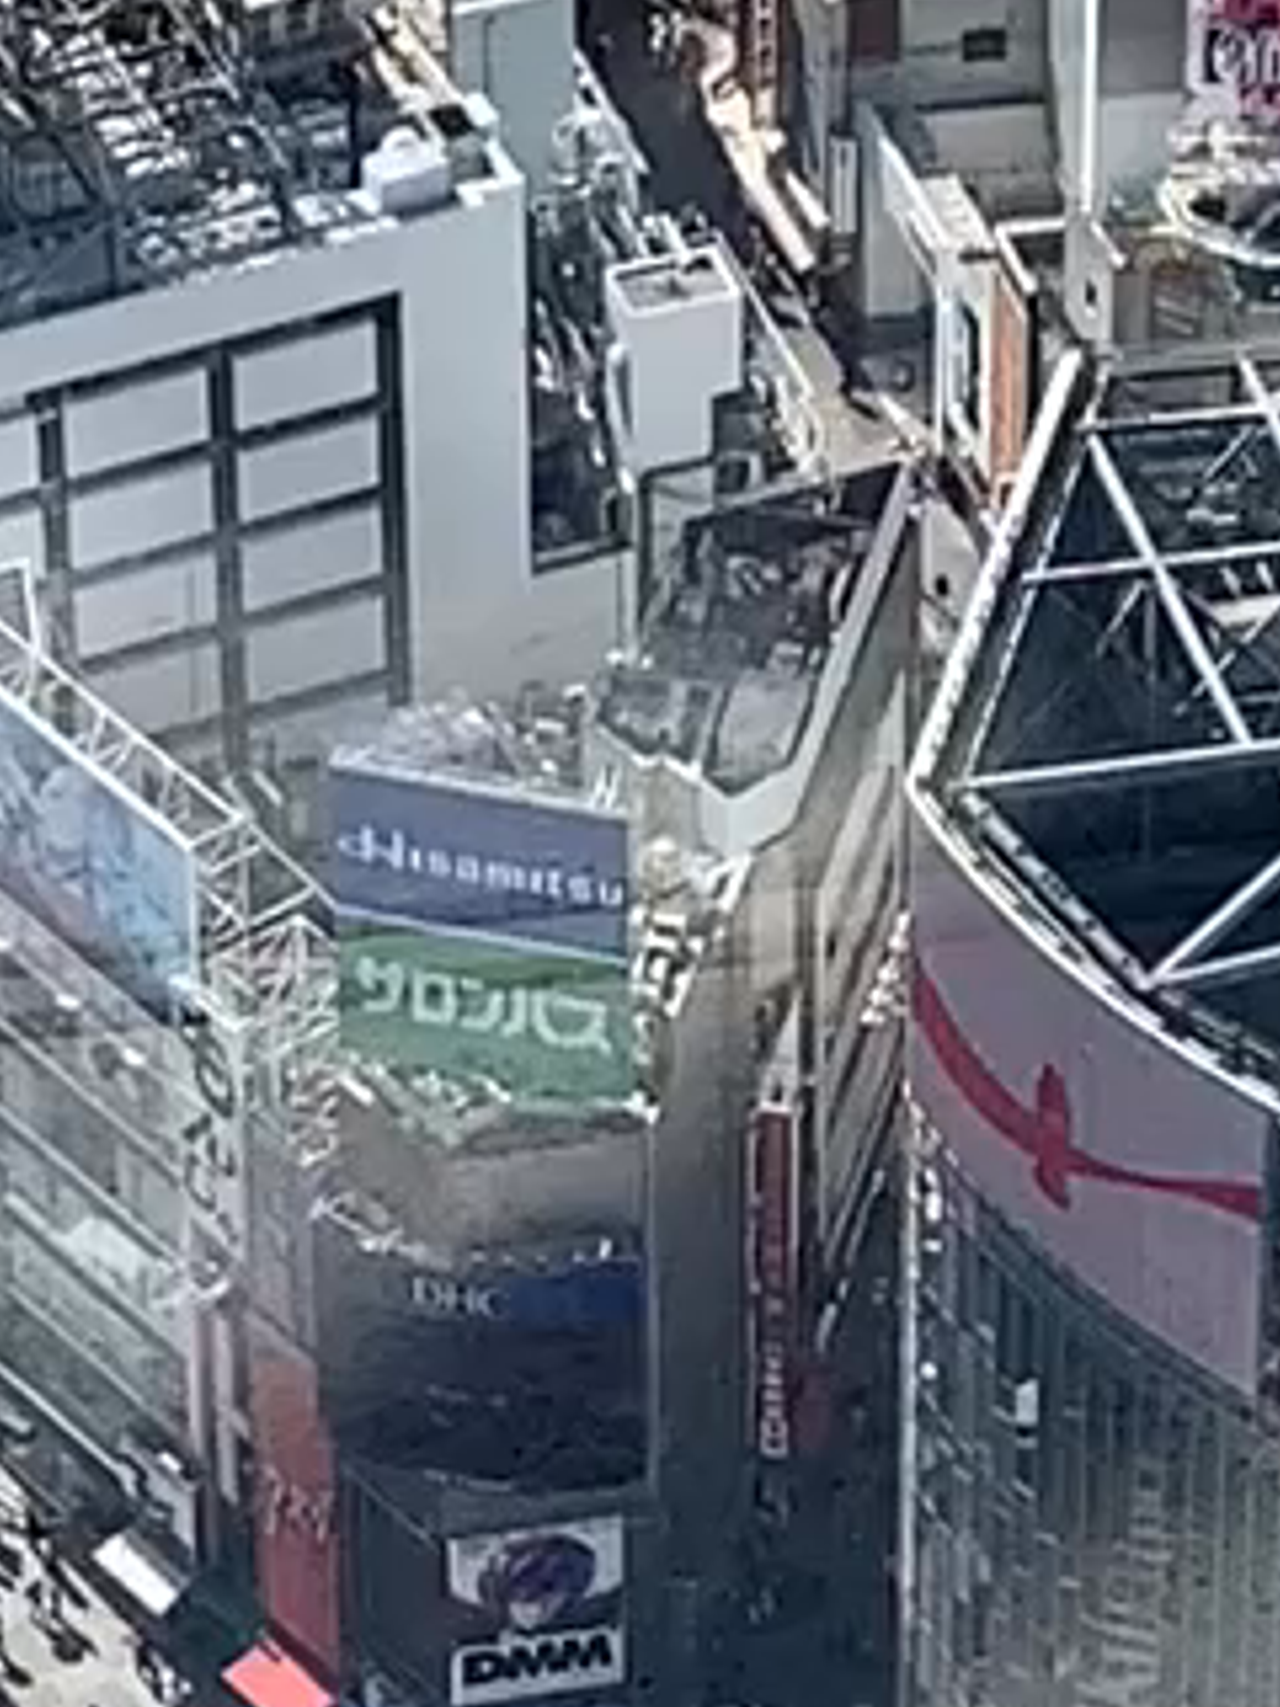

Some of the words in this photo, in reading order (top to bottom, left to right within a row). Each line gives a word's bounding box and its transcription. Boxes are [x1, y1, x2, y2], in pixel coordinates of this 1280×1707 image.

[337, 824, 624, 907] Hisamitsu
[355, 955, 613, 1056] サロンパス
[461, 1632, 614, 1687] DMM
